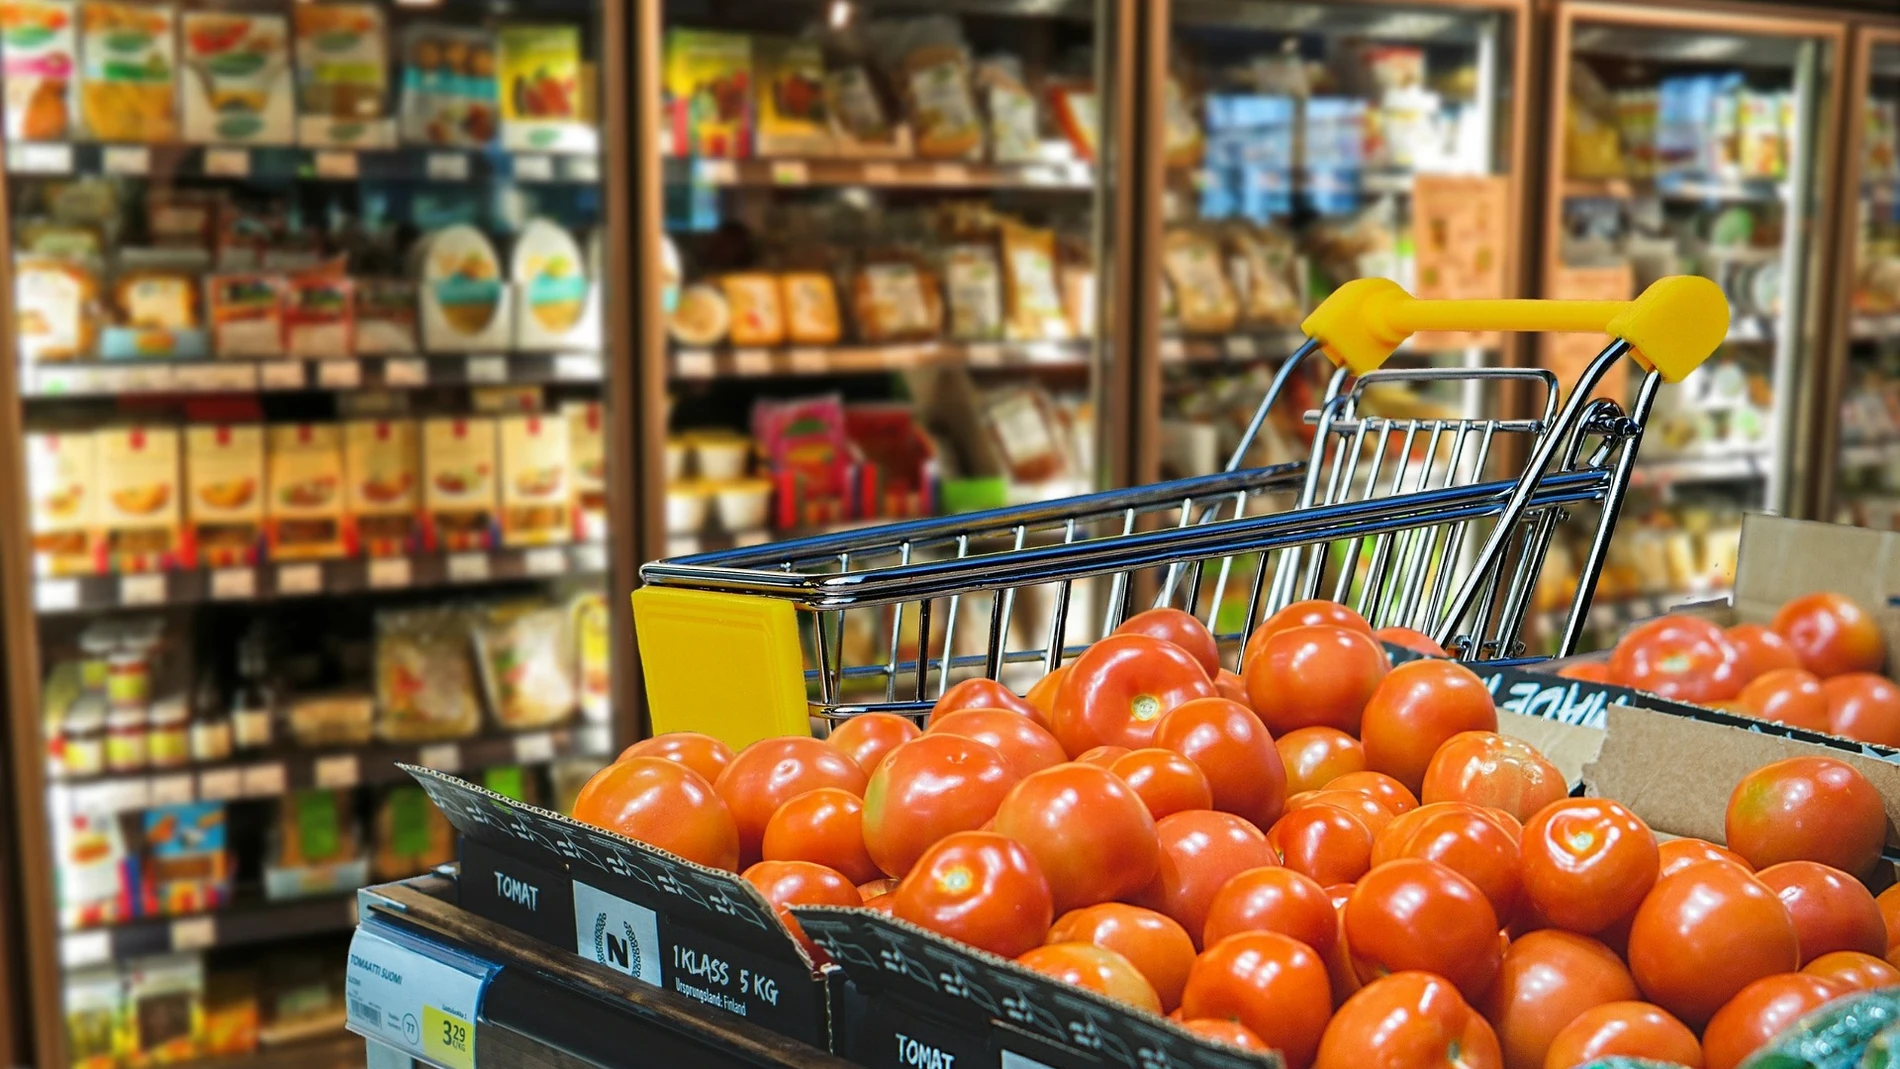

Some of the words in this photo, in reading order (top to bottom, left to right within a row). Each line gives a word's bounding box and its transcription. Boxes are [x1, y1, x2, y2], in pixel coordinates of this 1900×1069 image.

[1503, 682, 1629, 729] MADE
[494, 871, 538, 911] TOMAT
[606, 932, 629, 969] N
[350, 954, 381, 977] TOMAATTI
[381, 968, 403, 985] SUOMI
[740, 969, 749, 993] 5
[754, 973, 779, 1006] KG
[675, 977, 723, 1008] Ursprungsland:
[723, 995, 747, 1016] Finland
[406, 1022, 415, 1034] 77
[895, 1033, 955, 1069] TOMAT
